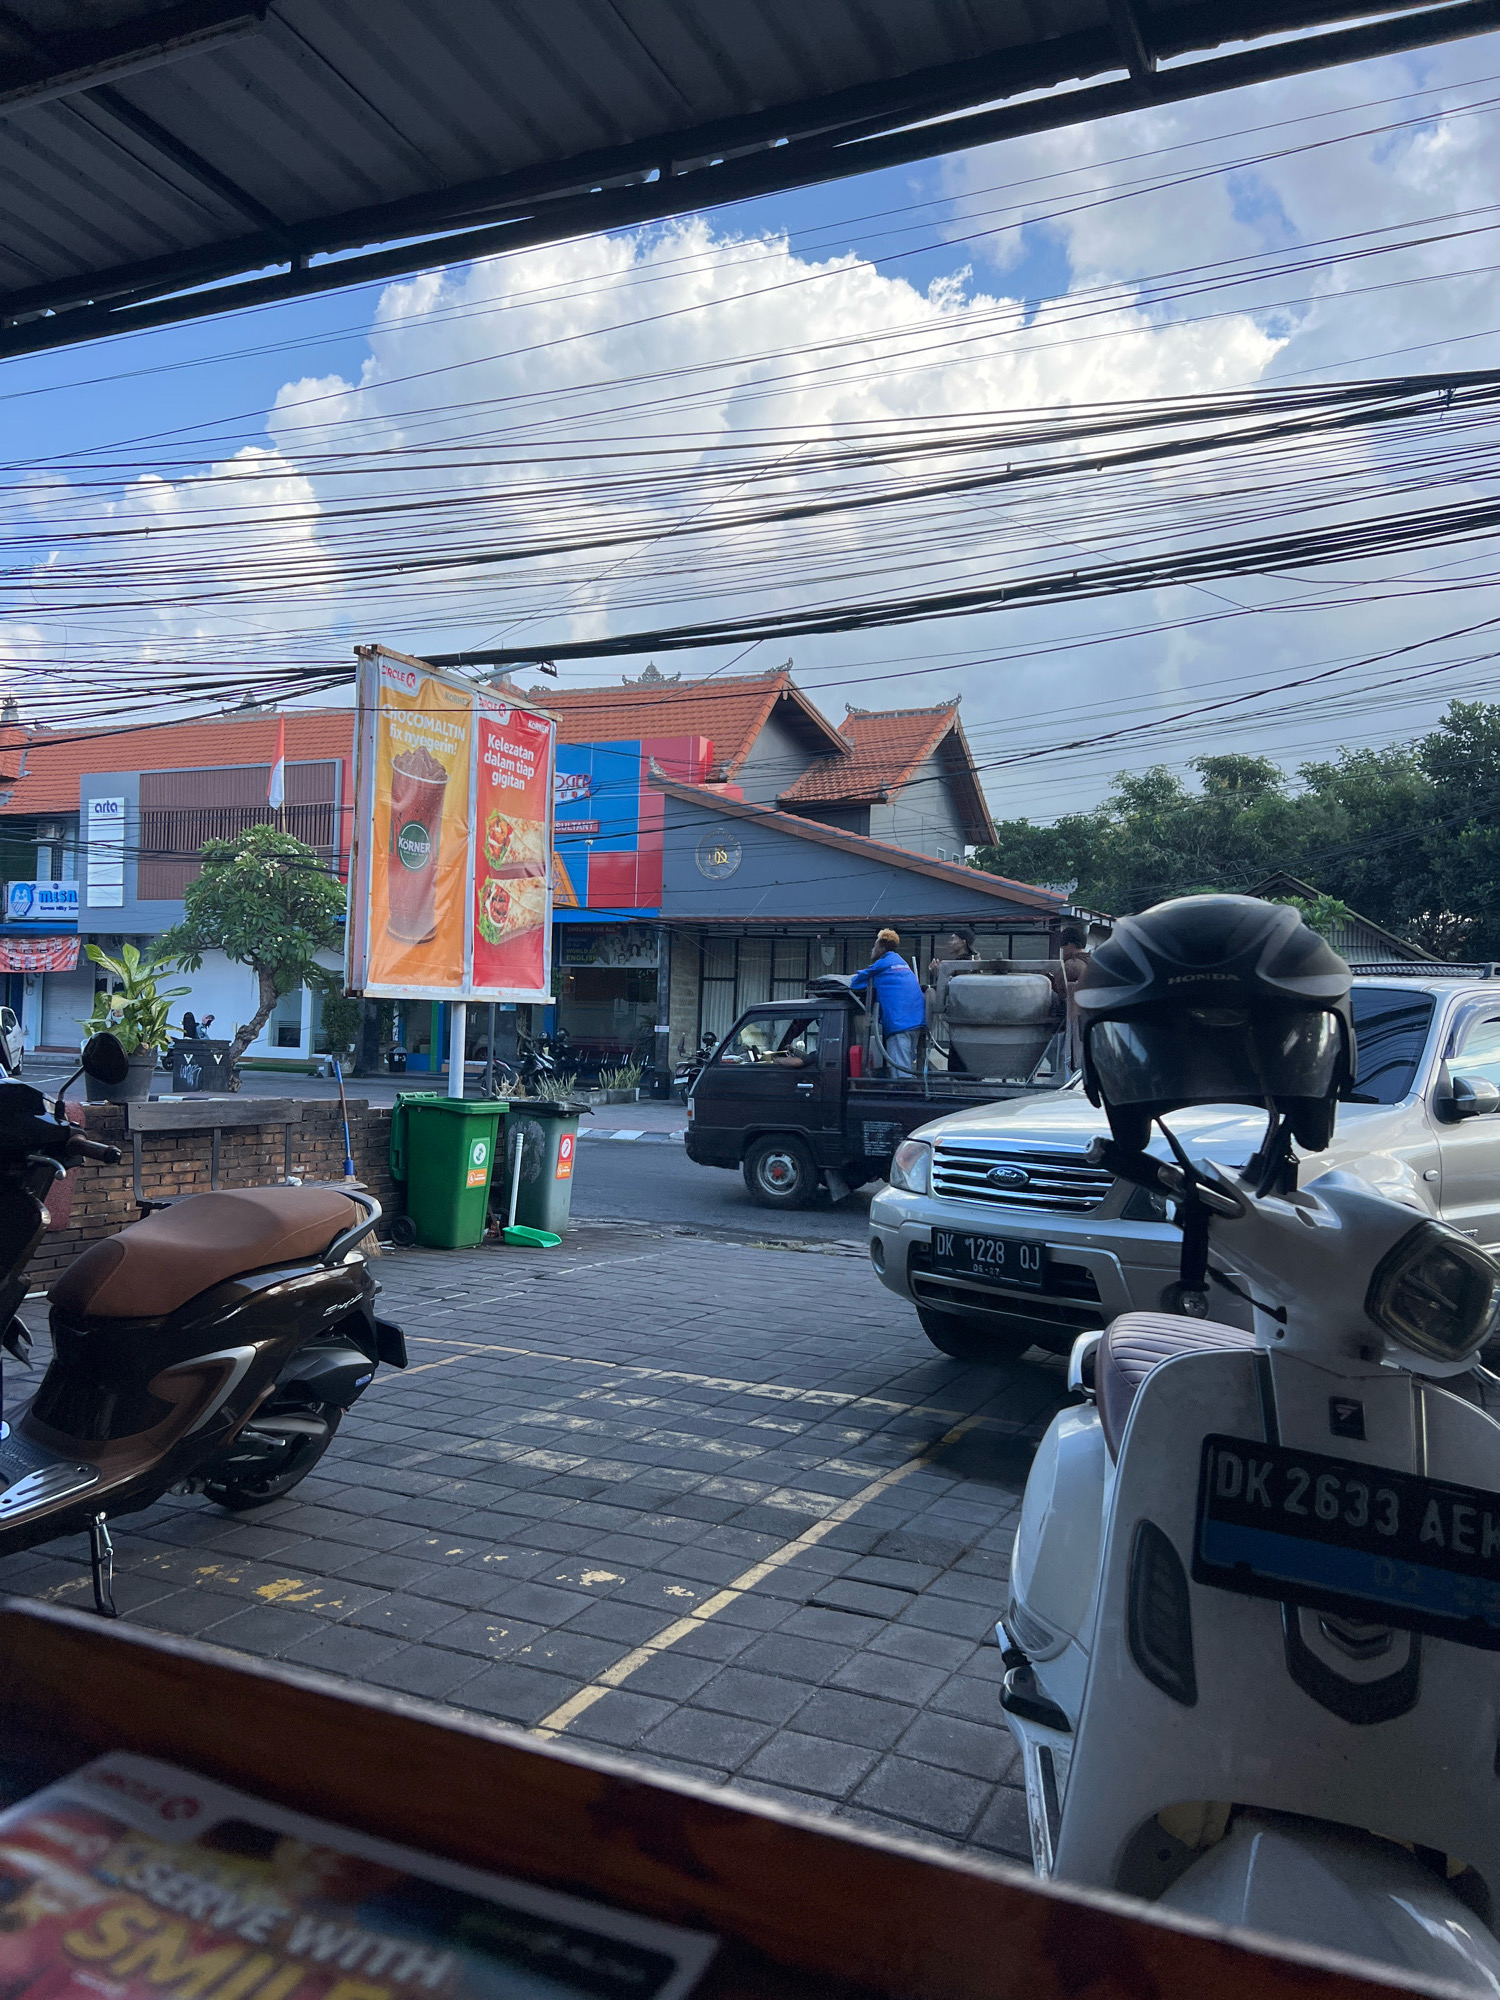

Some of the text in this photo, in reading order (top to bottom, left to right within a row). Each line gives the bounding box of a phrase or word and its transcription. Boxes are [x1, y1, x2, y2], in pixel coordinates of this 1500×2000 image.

[382, 665, 405, 682] CIRCLE
[382, 704, 465, 742] CHOCOMALTIN
[390, 724, 457, 755] fix nyegerin!
[488, 733, 534, 762] Kelezatan
[484, 751, 535, 780] dalam tiap
[492, 769, 525, 791] gigitan
[94, 800, 118, 813] arta
[554, 821, 595, 831] SULTANT
[1167, 973, 1240, 985] HONDA
[937, 1232, 1040, 1270] DK 1228 QJ
[1216, 1451, 1274, 1509] DK
[1283, 1467, 1400, 1536] 2633
[129, 1861, 291, 1943] SERVE
[287, 1914, 457, 1988] WITH
